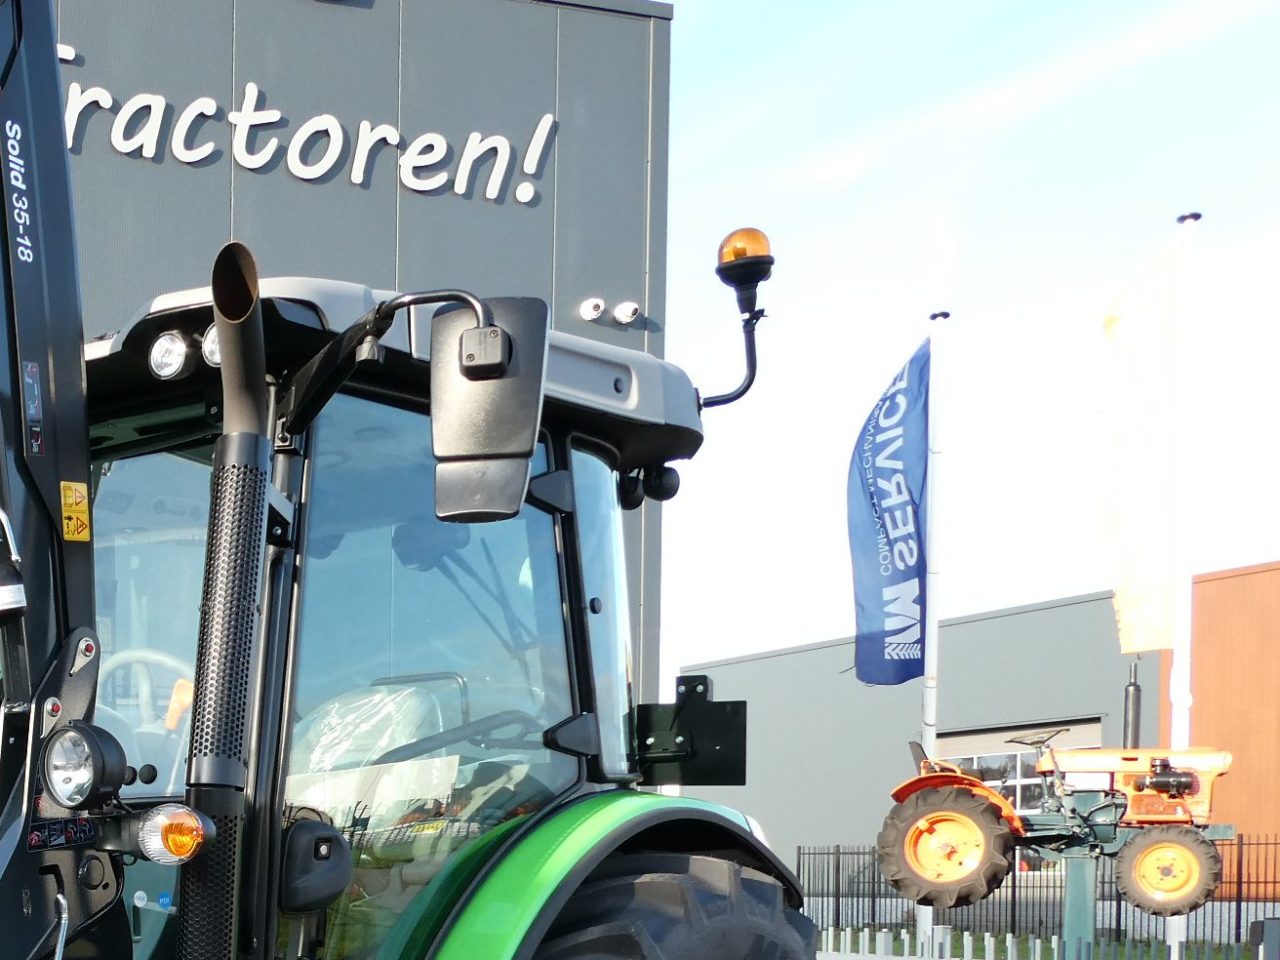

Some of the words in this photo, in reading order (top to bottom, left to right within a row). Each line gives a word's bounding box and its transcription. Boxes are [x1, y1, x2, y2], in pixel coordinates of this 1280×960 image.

[6, 120, 26, 190] Solid
[57, 44, 554, 203] ractoren!
[12, 193, 33, 262] 35-18
